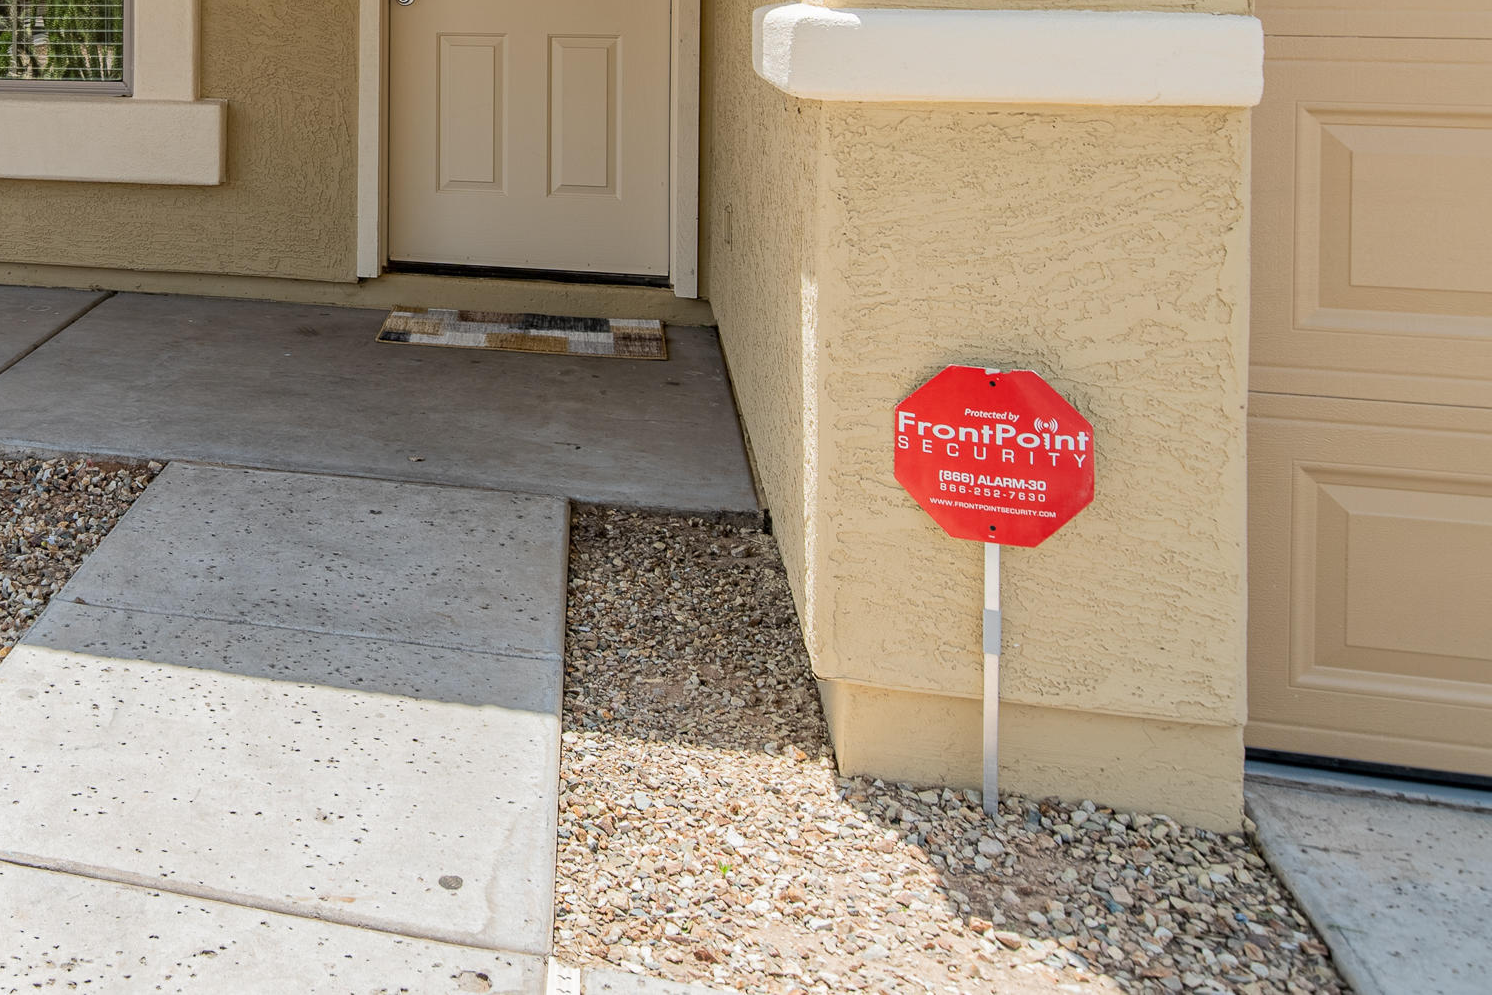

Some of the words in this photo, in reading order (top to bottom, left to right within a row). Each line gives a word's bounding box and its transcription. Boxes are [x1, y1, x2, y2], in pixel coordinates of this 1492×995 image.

[964, 408, 1006, 420] Protected
[1007, 412, 1020, 422] by
[898, 411, 1089, 451] FrontPoint
[897, 436, 1086, 468] SECURITY
[939, 470, 975, 486] (866)
[977, 475, 1047, 491] ALARM-30
[940, 483, 1046, 502] 866-252-7630
[929, 497, 1057, 518] WWW.FRONTPOINTSECURITY.COM
